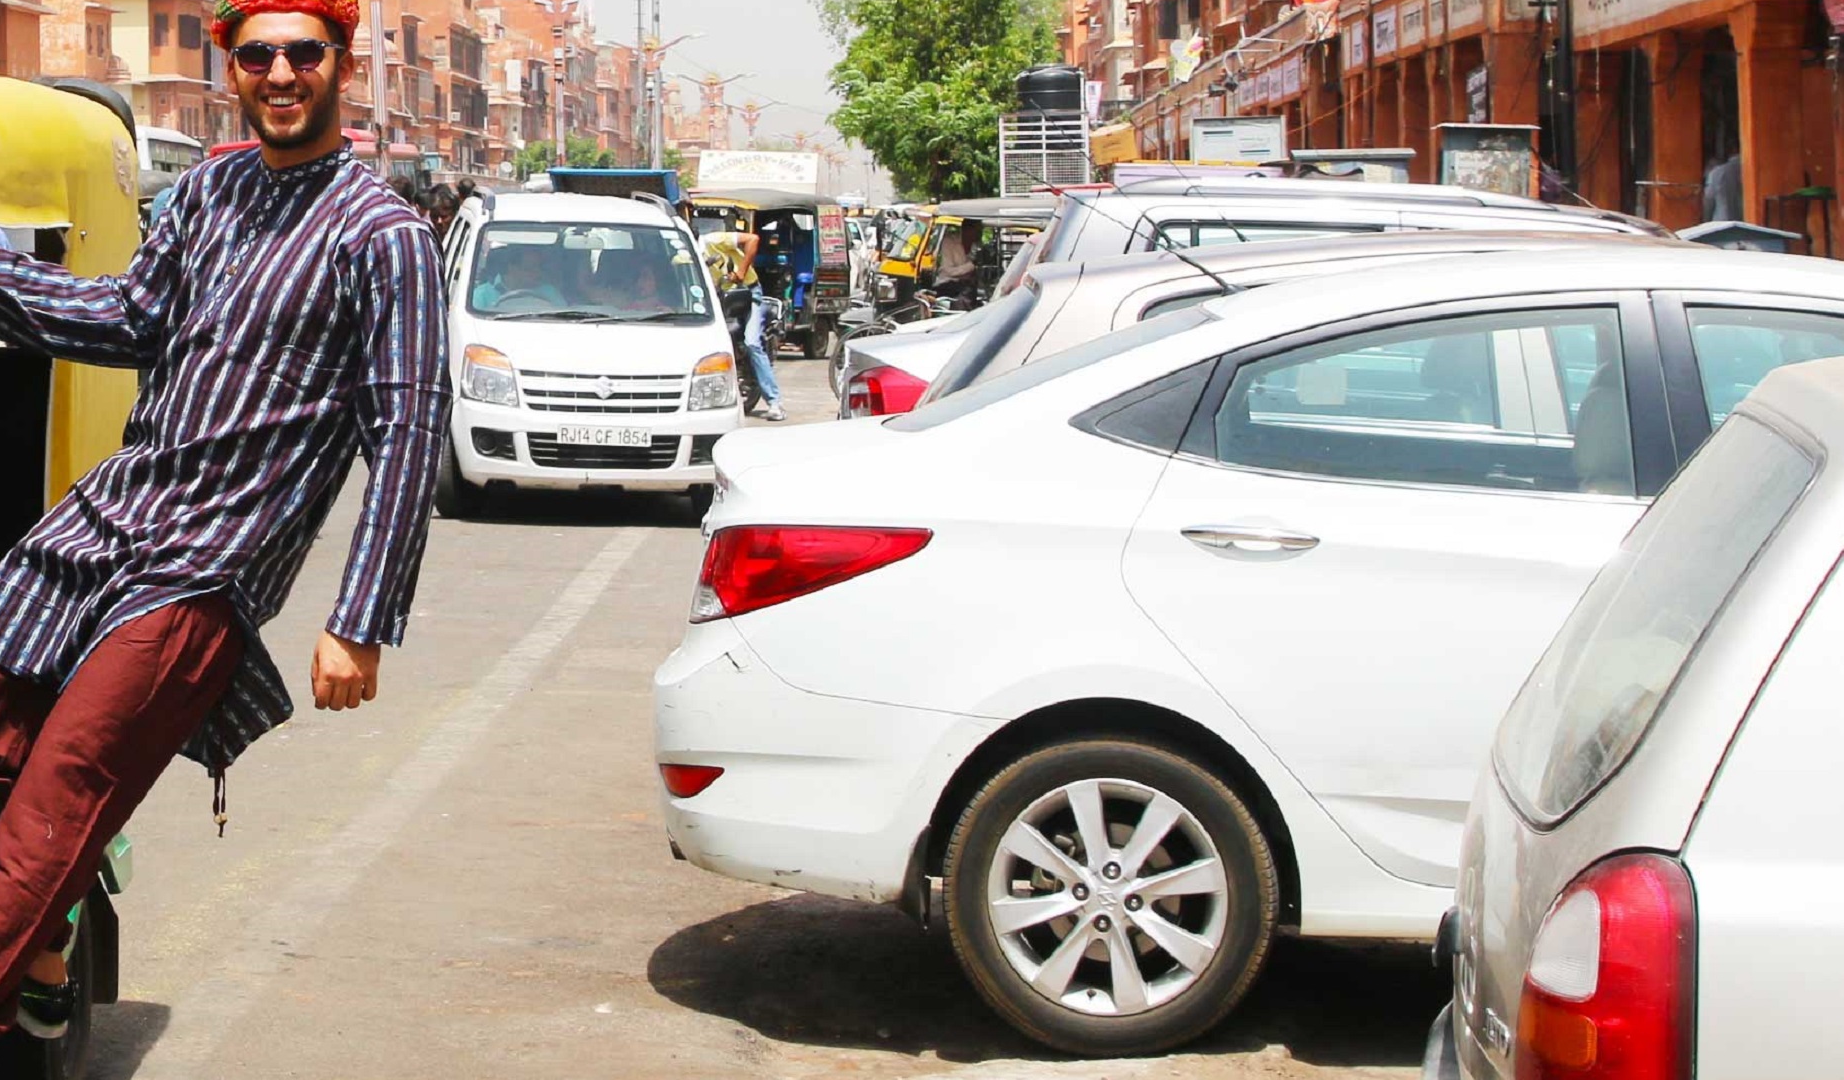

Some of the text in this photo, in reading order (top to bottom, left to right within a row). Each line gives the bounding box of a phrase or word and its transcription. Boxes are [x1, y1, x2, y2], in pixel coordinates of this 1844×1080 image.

[560, 427, 648, 445] RJ14 CF 1854
